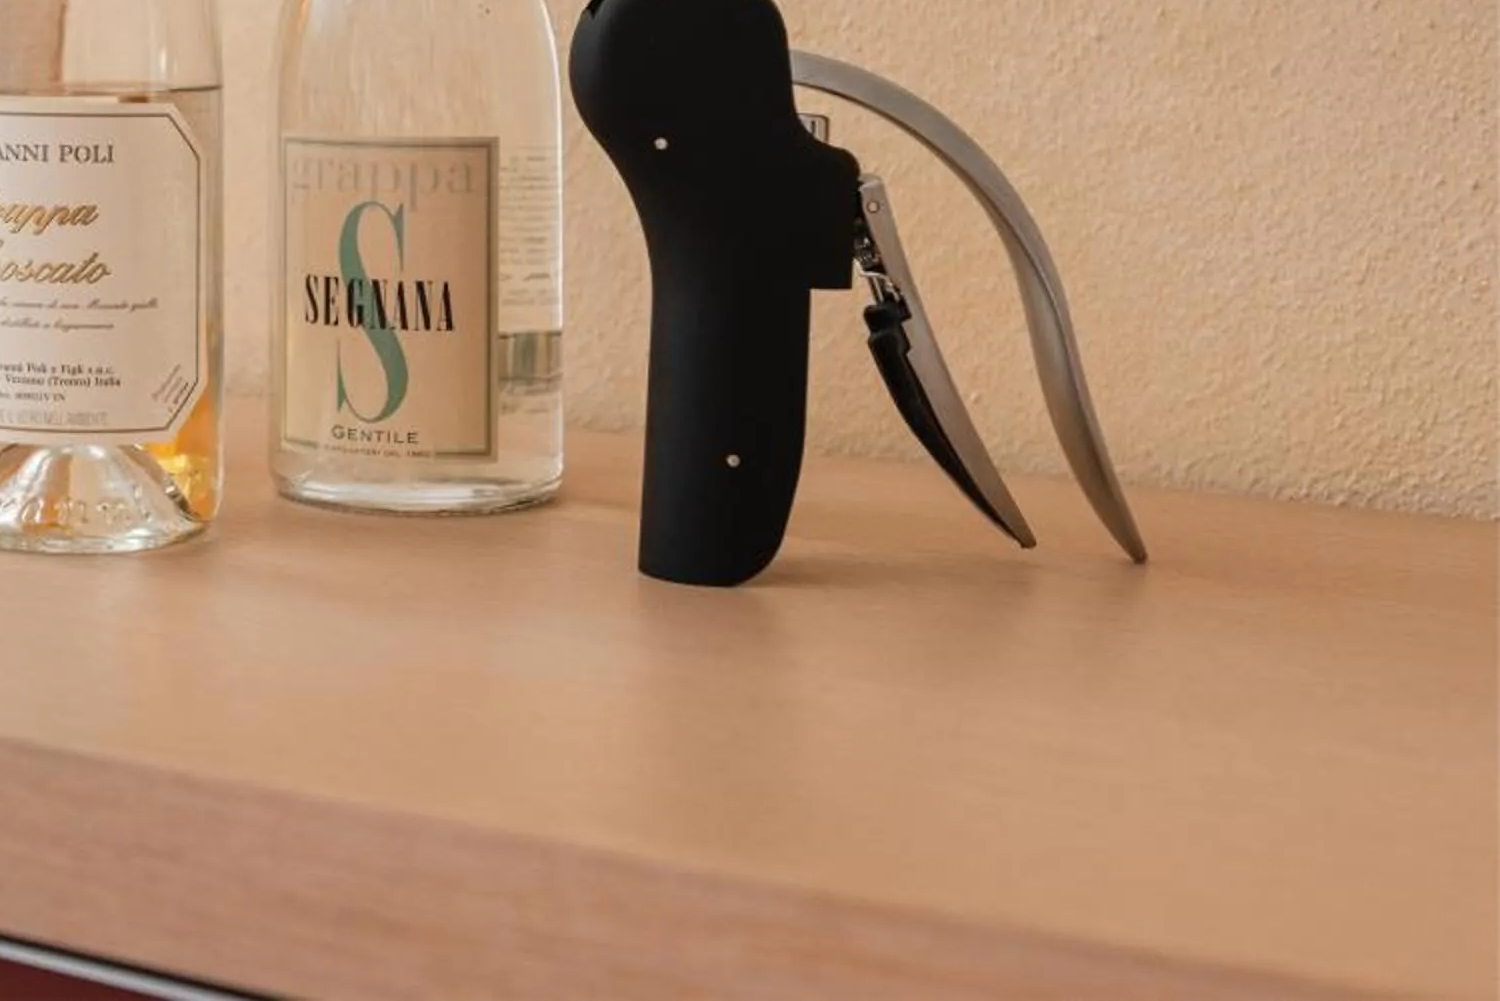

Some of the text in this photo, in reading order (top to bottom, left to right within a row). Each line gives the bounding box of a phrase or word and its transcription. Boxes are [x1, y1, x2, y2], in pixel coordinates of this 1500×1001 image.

[59, 143, 114, 164] POLI
[304, 273, 455, 333] SEGNANA
[331, 424, 420, 445] GENTILE
